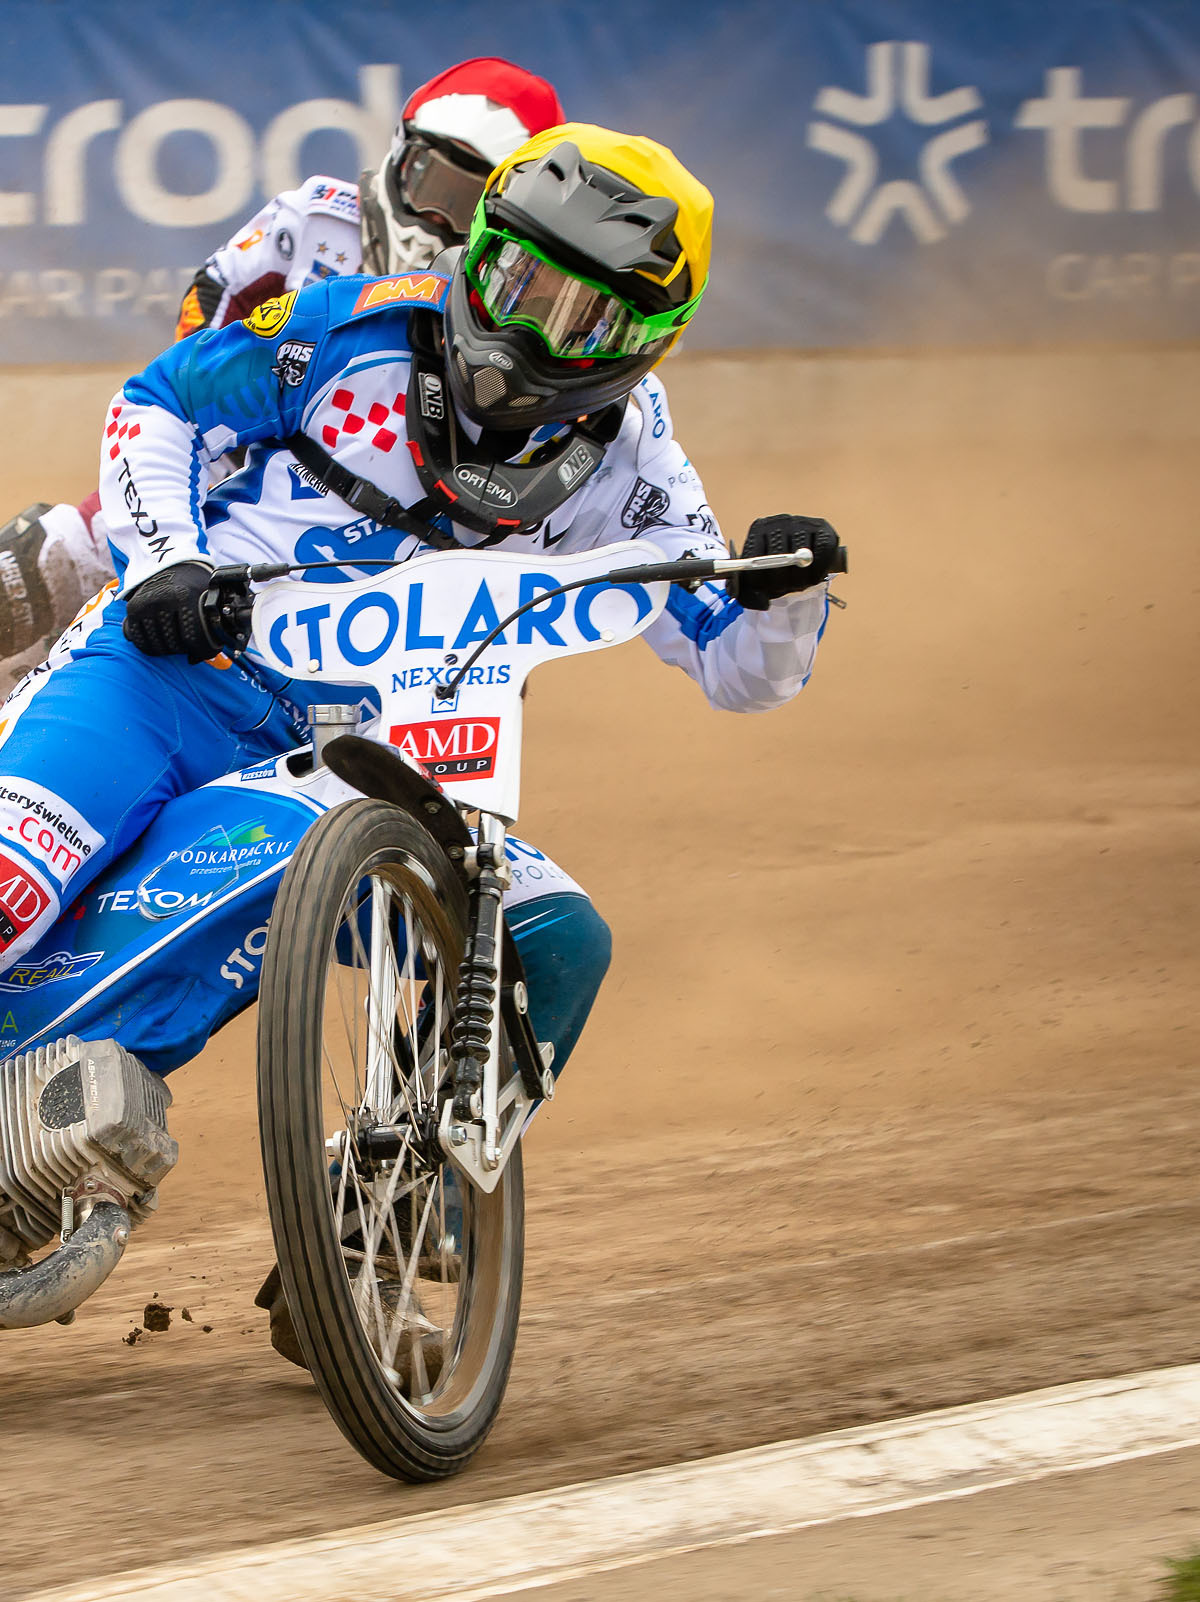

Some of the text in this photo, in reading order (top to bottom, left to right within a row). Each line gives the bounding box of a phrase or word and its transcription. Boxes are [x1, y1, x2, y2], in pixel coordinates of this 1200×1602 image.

[1014, 66, 1200, 212] tr
[277, 344, 314, 362] PRS
[458, 469, 513, 504] ORTEMA
[391, 664, 511, 693] NEXORIS
[400, 723, 496, 759] AMD
[434, 760, 488, 774] OUP
[97, 887, 214, 915] TEXOM
